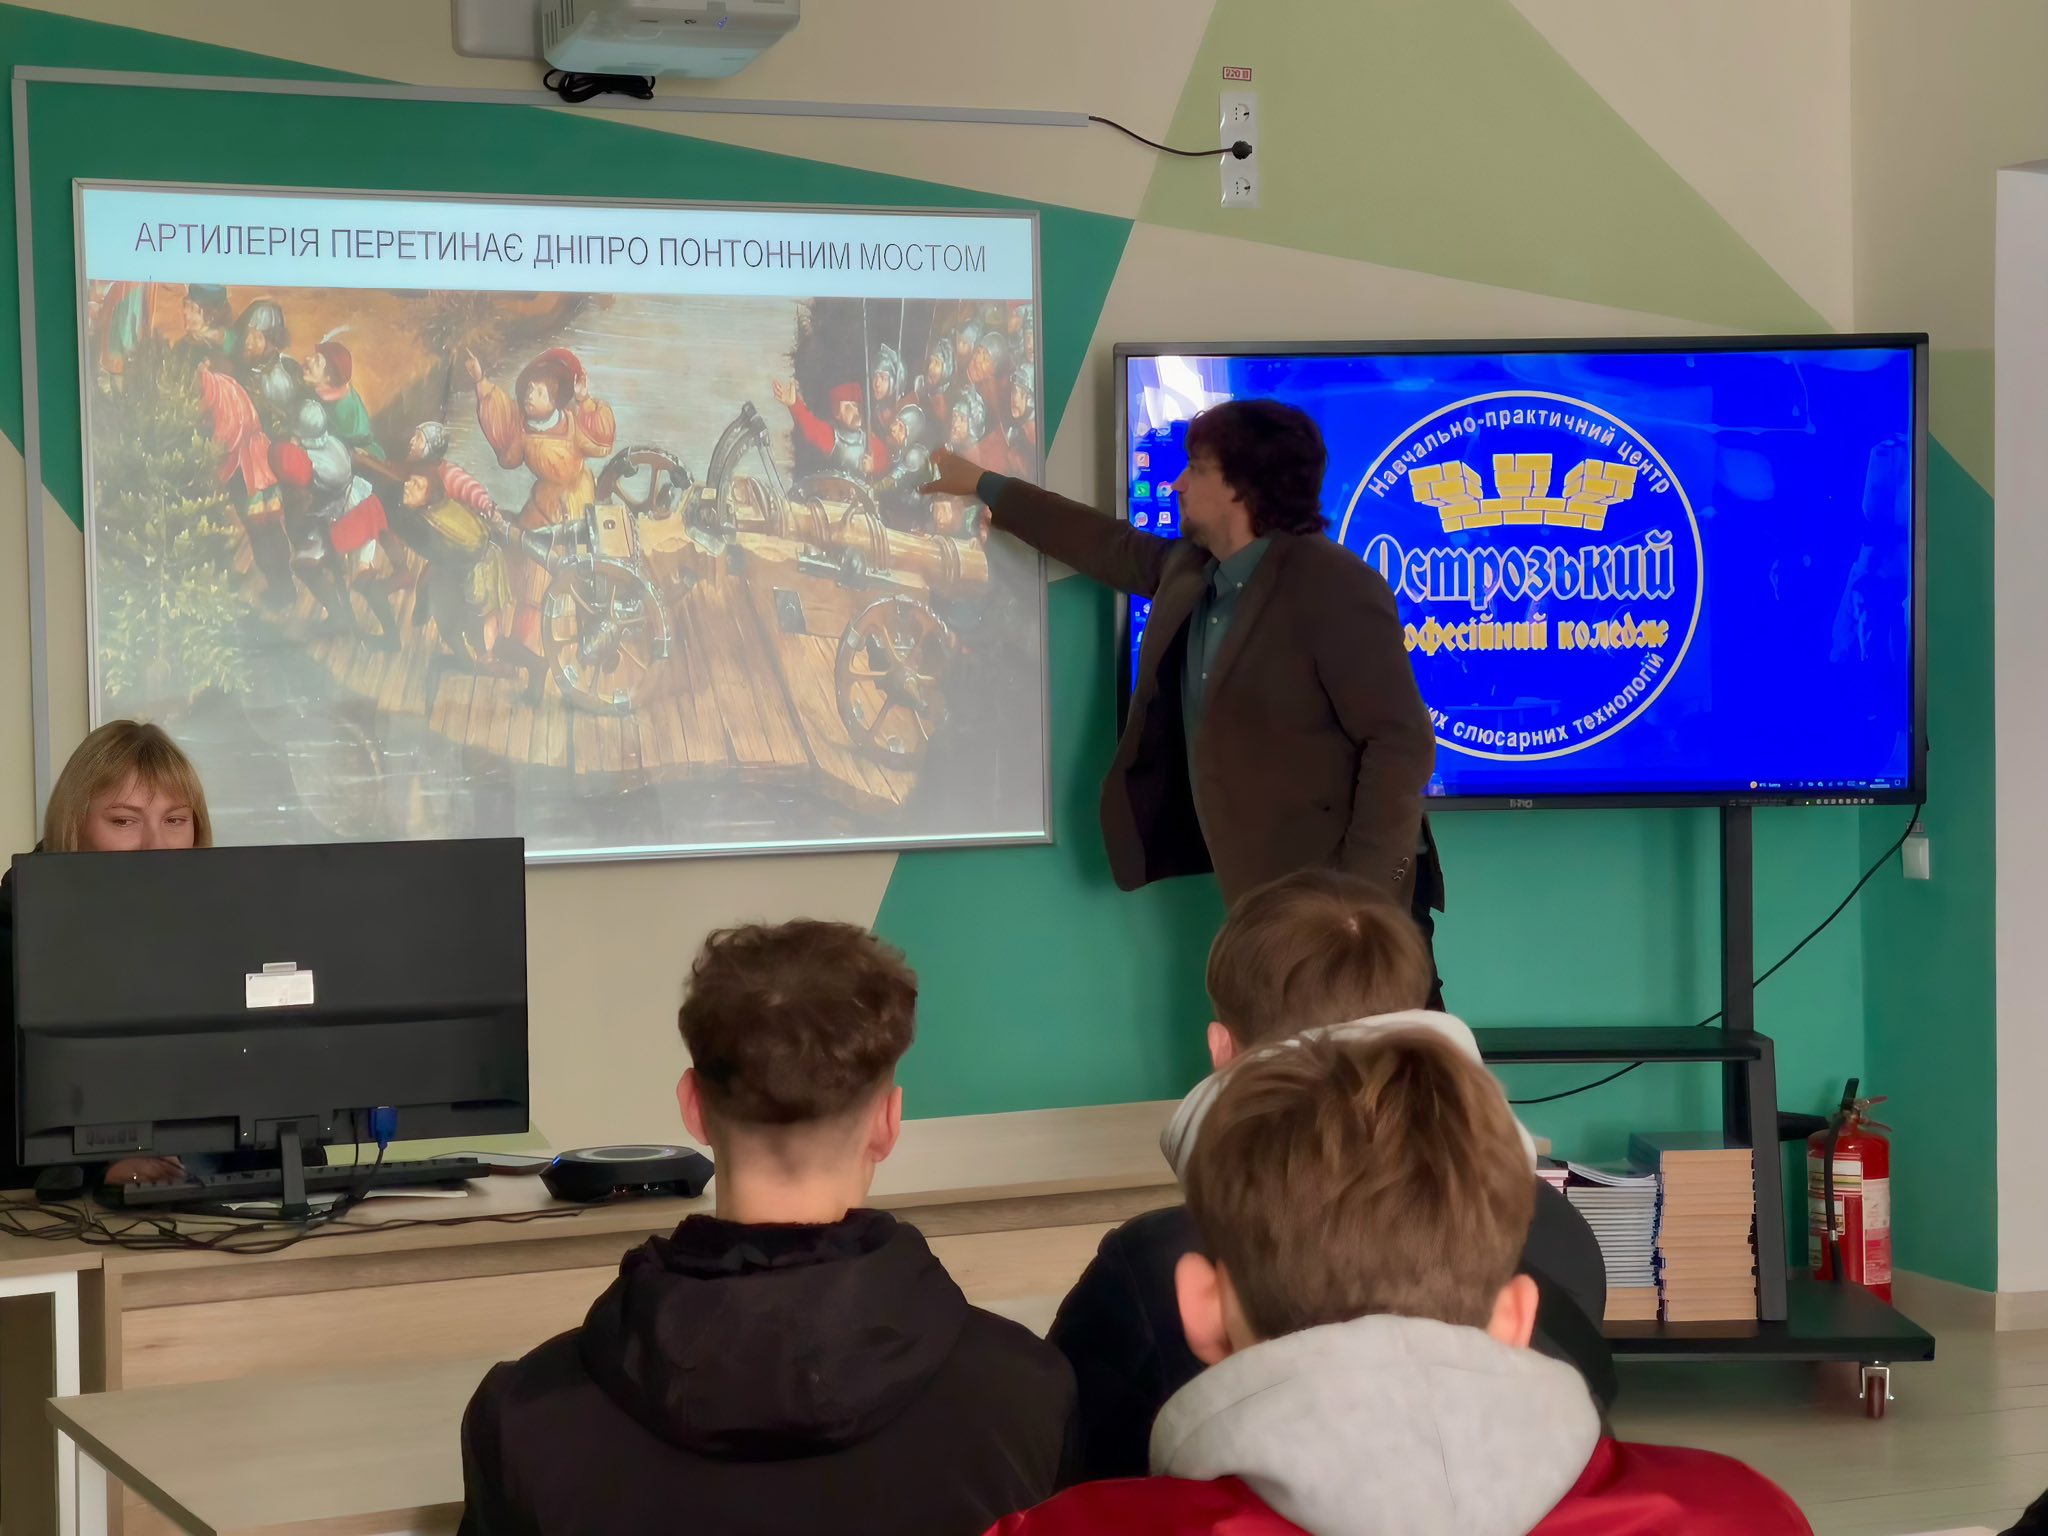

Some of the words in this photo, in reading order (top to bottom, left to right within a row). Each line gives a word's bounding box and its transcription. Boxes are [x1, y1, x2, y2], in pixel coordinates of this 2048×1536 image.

[135, 222, 319, 257] АРТИЛЕРІЯ
[331, 229, 523, 262] ПЕРЕТИНАЄ
[533, 233, 648, 269] ДНІПРО
[659, 237, 850, 270] ПОНТОННИМ
[859, 242, 986, 272] МОСТОМ
[1368, 408, 1616, 497] Навчально-практичний
[1617, 440, 1671, 494] центр
[1362, 529, 1676, 611] Острозький
[1403, 611, 1548, 656] офесійний
[1557, 611, 1669, 652] коледж
[1452, 721, 1570, 753] слюсарних
[1572, 651, 1665, 735] технологій
